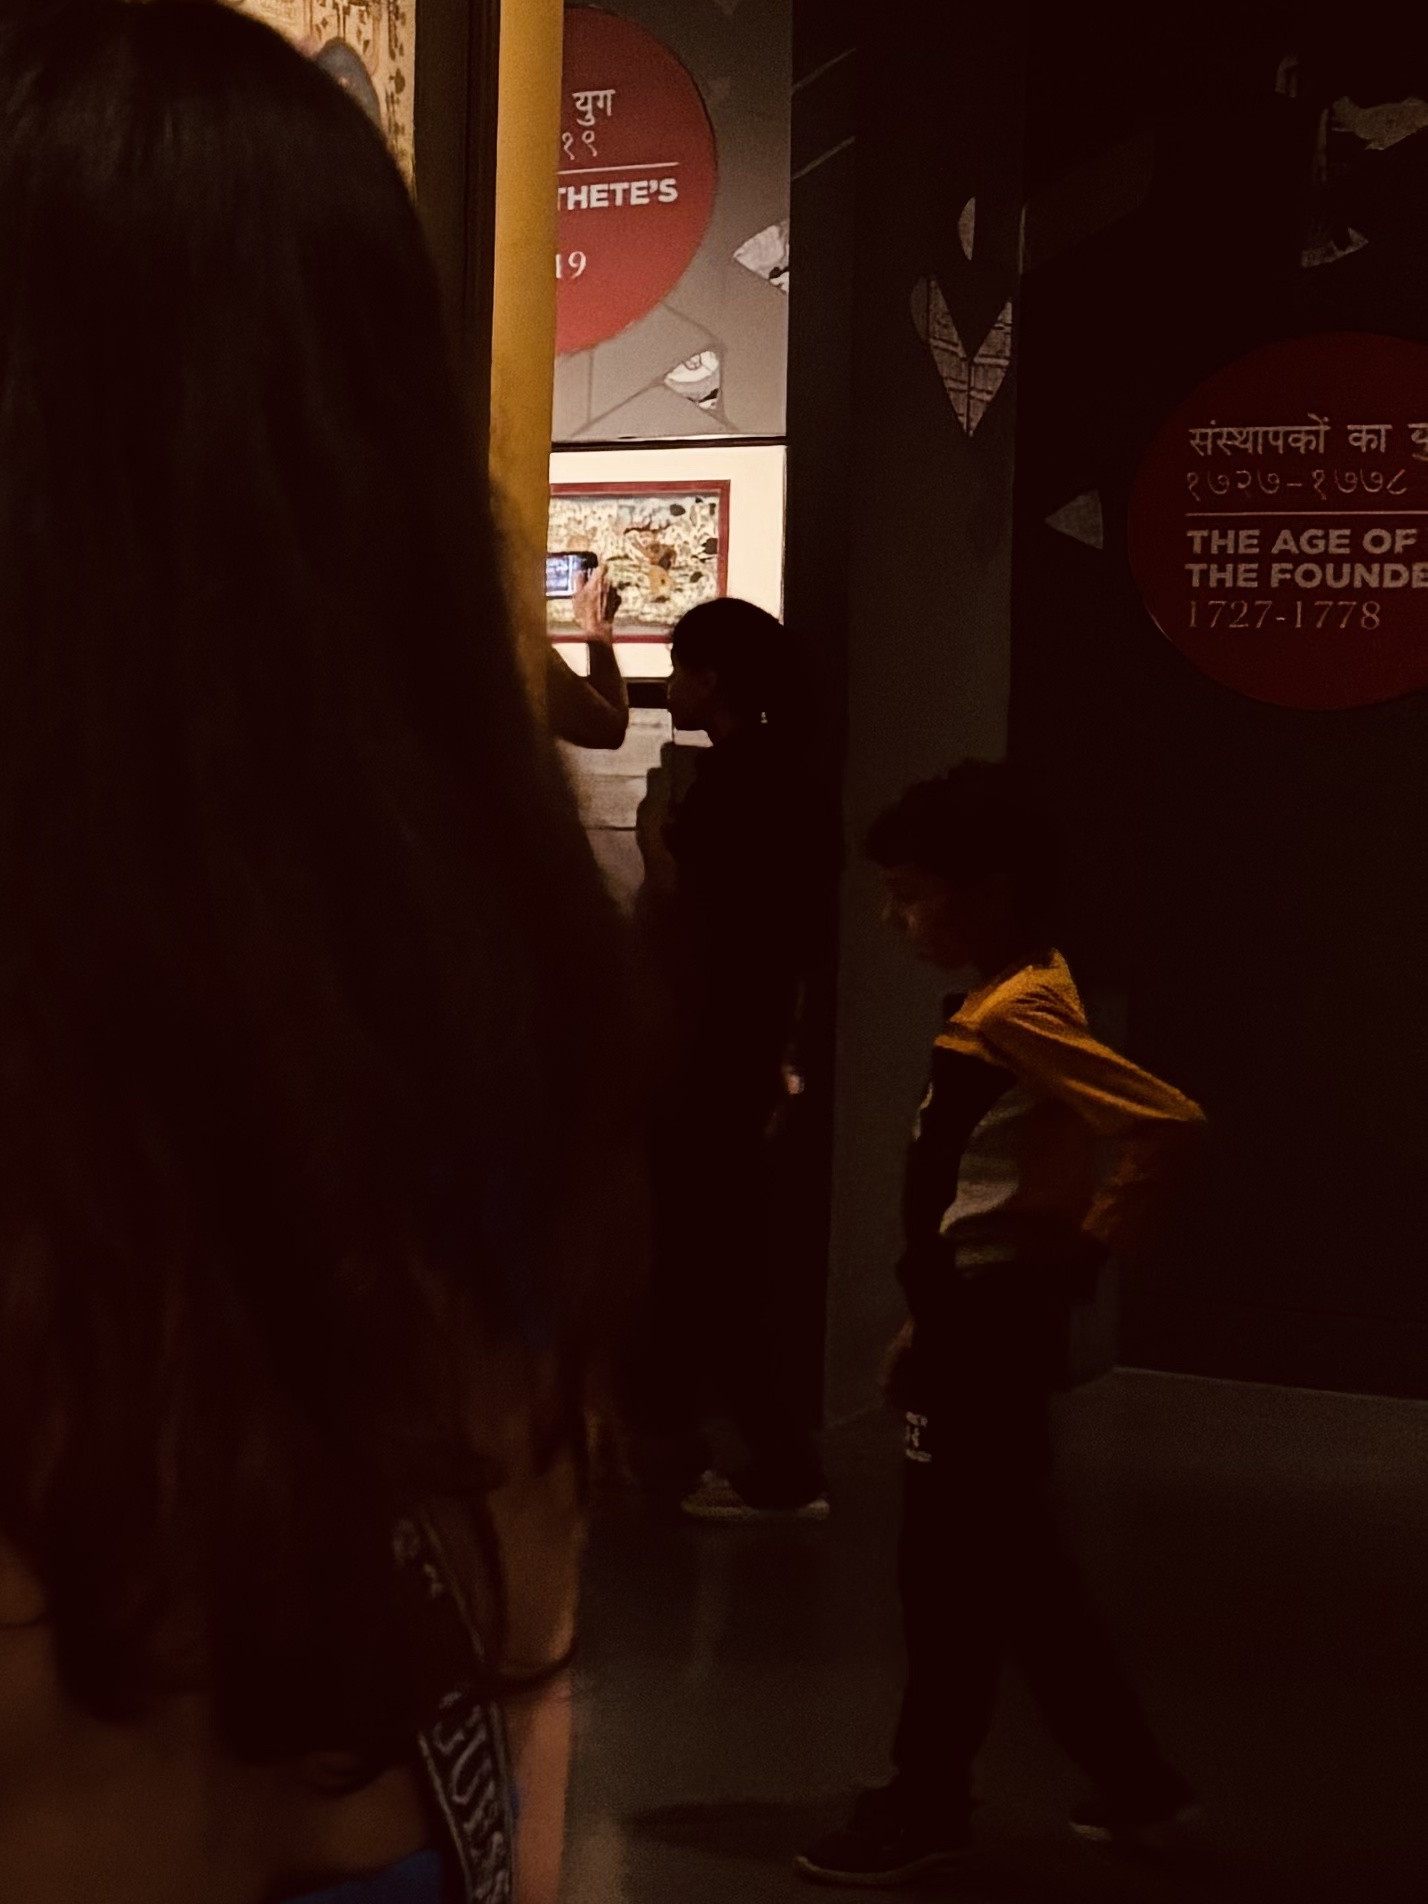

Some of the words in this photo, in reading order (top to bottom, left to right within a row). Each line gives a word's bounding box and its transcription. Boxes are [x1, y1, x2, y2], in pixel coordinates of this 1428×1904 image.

[571, 89, 616, 126] युग
[1188, 411, 1332, 457] संस्थापकों
[1346, 423, 1393, 453] का
[1186, 528, 1261, 555] THE
[1270, 527, 1352, 555] AGE
[1362, 527, 1418, 555] OF
[1184, 562, 1259, 589] THE
[1187, 600, 1381, 630] 1727-1778
